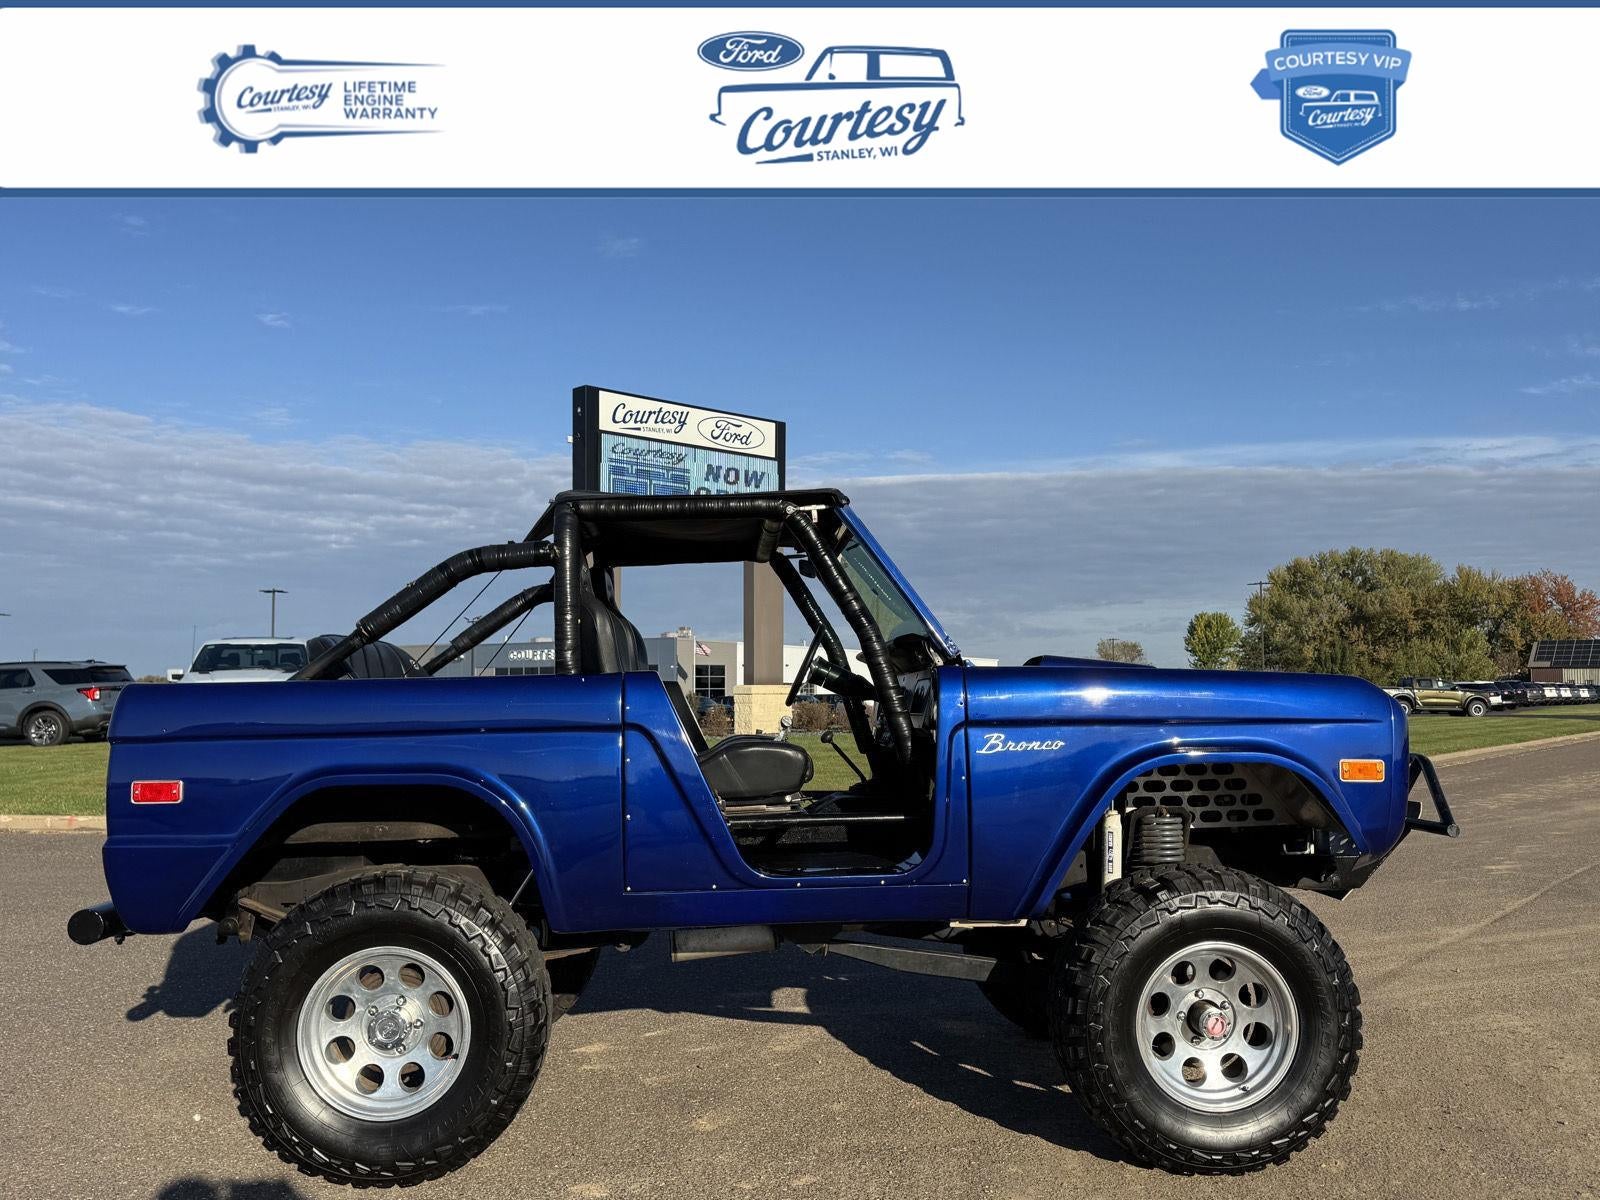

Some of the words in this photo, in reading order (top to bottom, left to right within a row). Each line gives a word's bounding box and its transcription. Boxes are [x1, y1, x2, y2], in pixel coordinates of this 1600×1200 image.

[611, 402, 690, 434] Courtesy
[710, 418, 753, 447] Ford
[704, 463, 766, 489] NOW
[508, 649, 556, 661] COURTE
[976, 732, 1066, 754] Bronco
